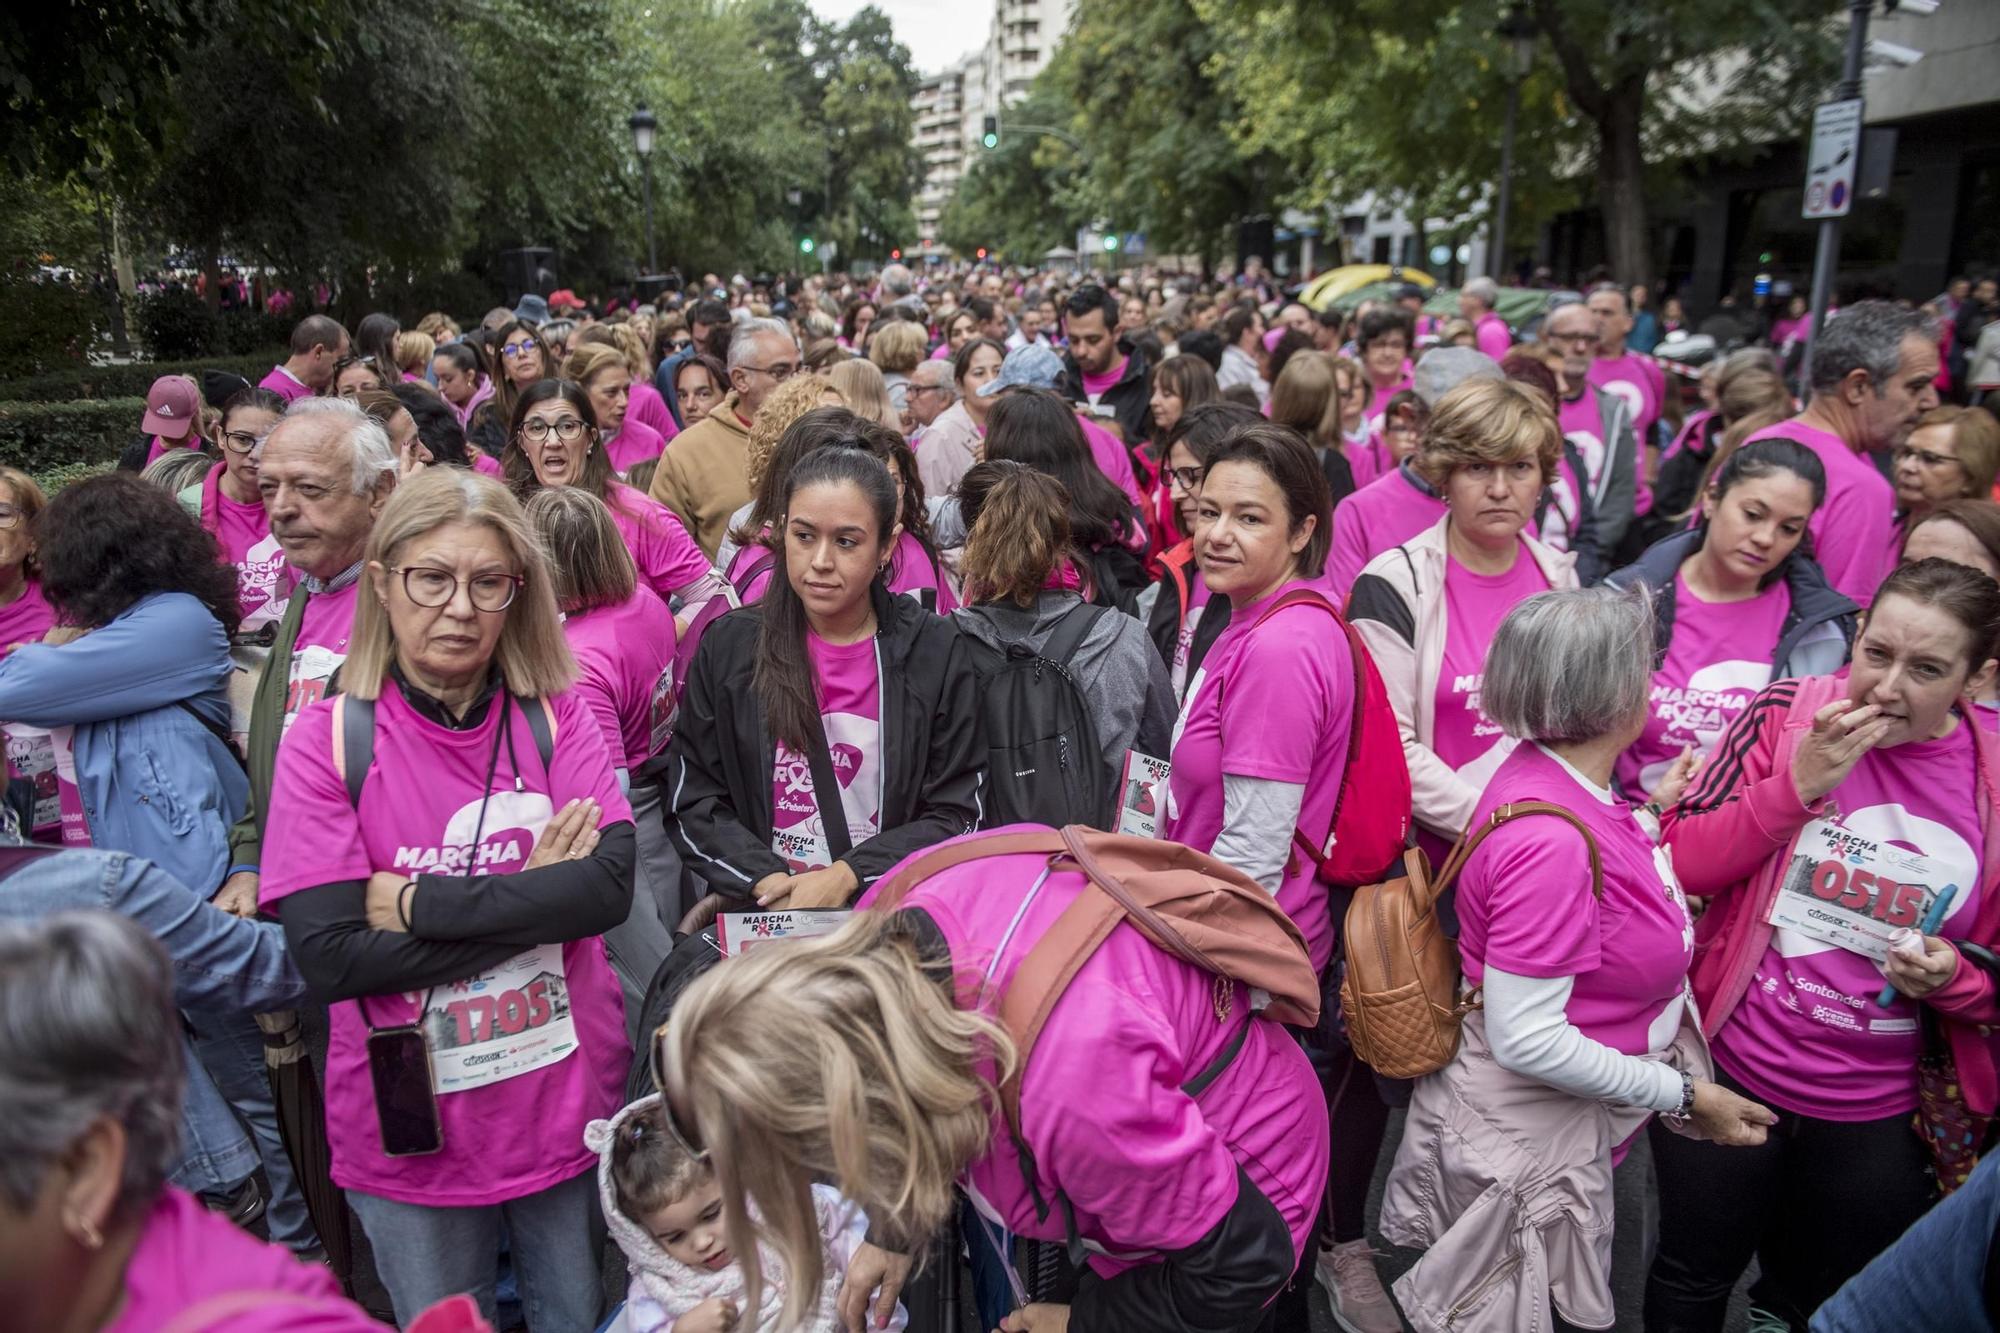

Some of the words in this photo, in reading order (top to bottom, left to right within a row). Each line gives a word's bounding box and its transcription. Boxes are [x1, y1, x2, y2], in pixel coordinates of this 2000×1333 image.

[1649, 685, 1747, 710] MARCHA
[773, 830, 815, 846] MARCHA
[1820, 828, 1878, 853] MARCHA
[393, 839, 522, 868] MARCHA
[742, 915, 793, 925] MARCHA
[1795, 977, 1867, 1010] Santander
[447, 979, 552, 1047] 1705
